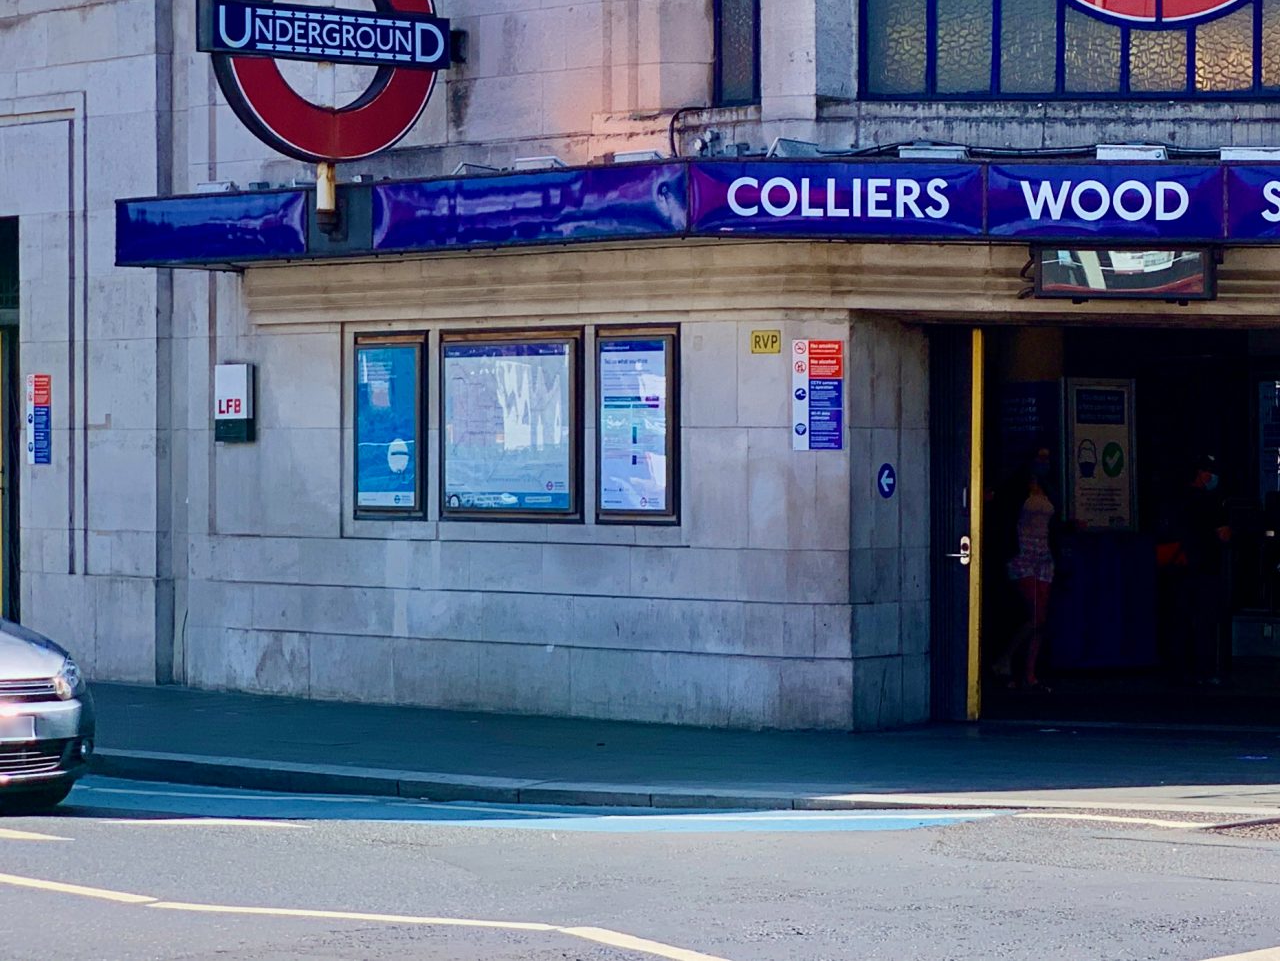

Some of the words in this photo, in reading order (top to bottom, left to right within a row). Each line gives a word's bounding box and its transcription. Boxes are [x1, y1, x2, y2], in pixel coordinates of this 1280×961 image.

[219, 5, 445, 63] UNDERGROUND
[727, 176, 950, 219] COLLIERS
[1020, 179, 1190, 221] WOOD
[754, 334, 778, 349] RVP
[218, 398, 242, 414] LFB
